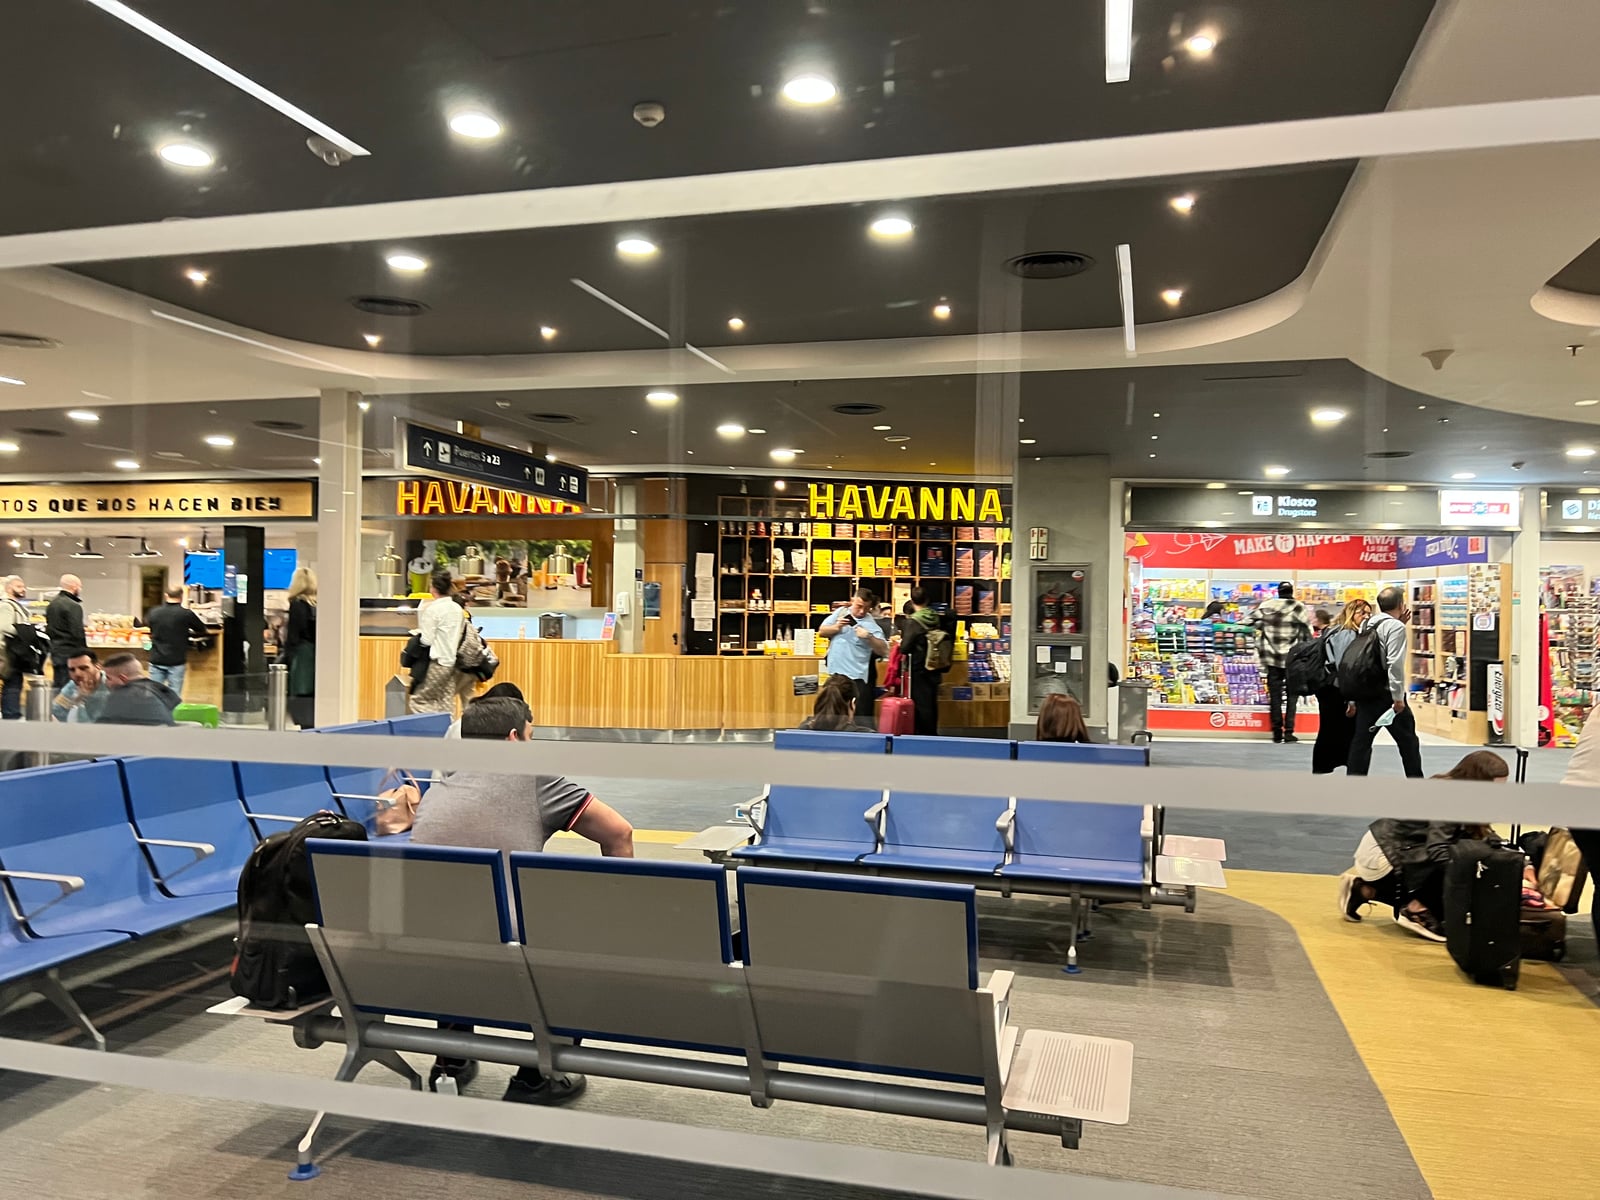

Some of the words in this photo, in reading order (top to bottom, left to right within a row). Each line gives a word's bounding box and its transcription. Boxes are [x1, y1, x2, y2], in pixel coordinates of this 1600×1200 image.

[481, 451, 486, 462] 5
[492, 454, 501, 465] 23
[49, 499, 88, 512] QUE
[97, 498, 136, 511] NOS
[149, 498, 219, 511] HACEN
[231, 497, 281, 511] BIEN
[809, 484, 1004, 521] HAVANNA
[1278, 496, 1317, 507] Kiosco
[1278, 508, 1317, 517] Drugstore
[1234, 536, 1274, 555] MAKE
[1360, 552, 1397, 562] HACES
[1492, 671, 1503, 712] Energizer
